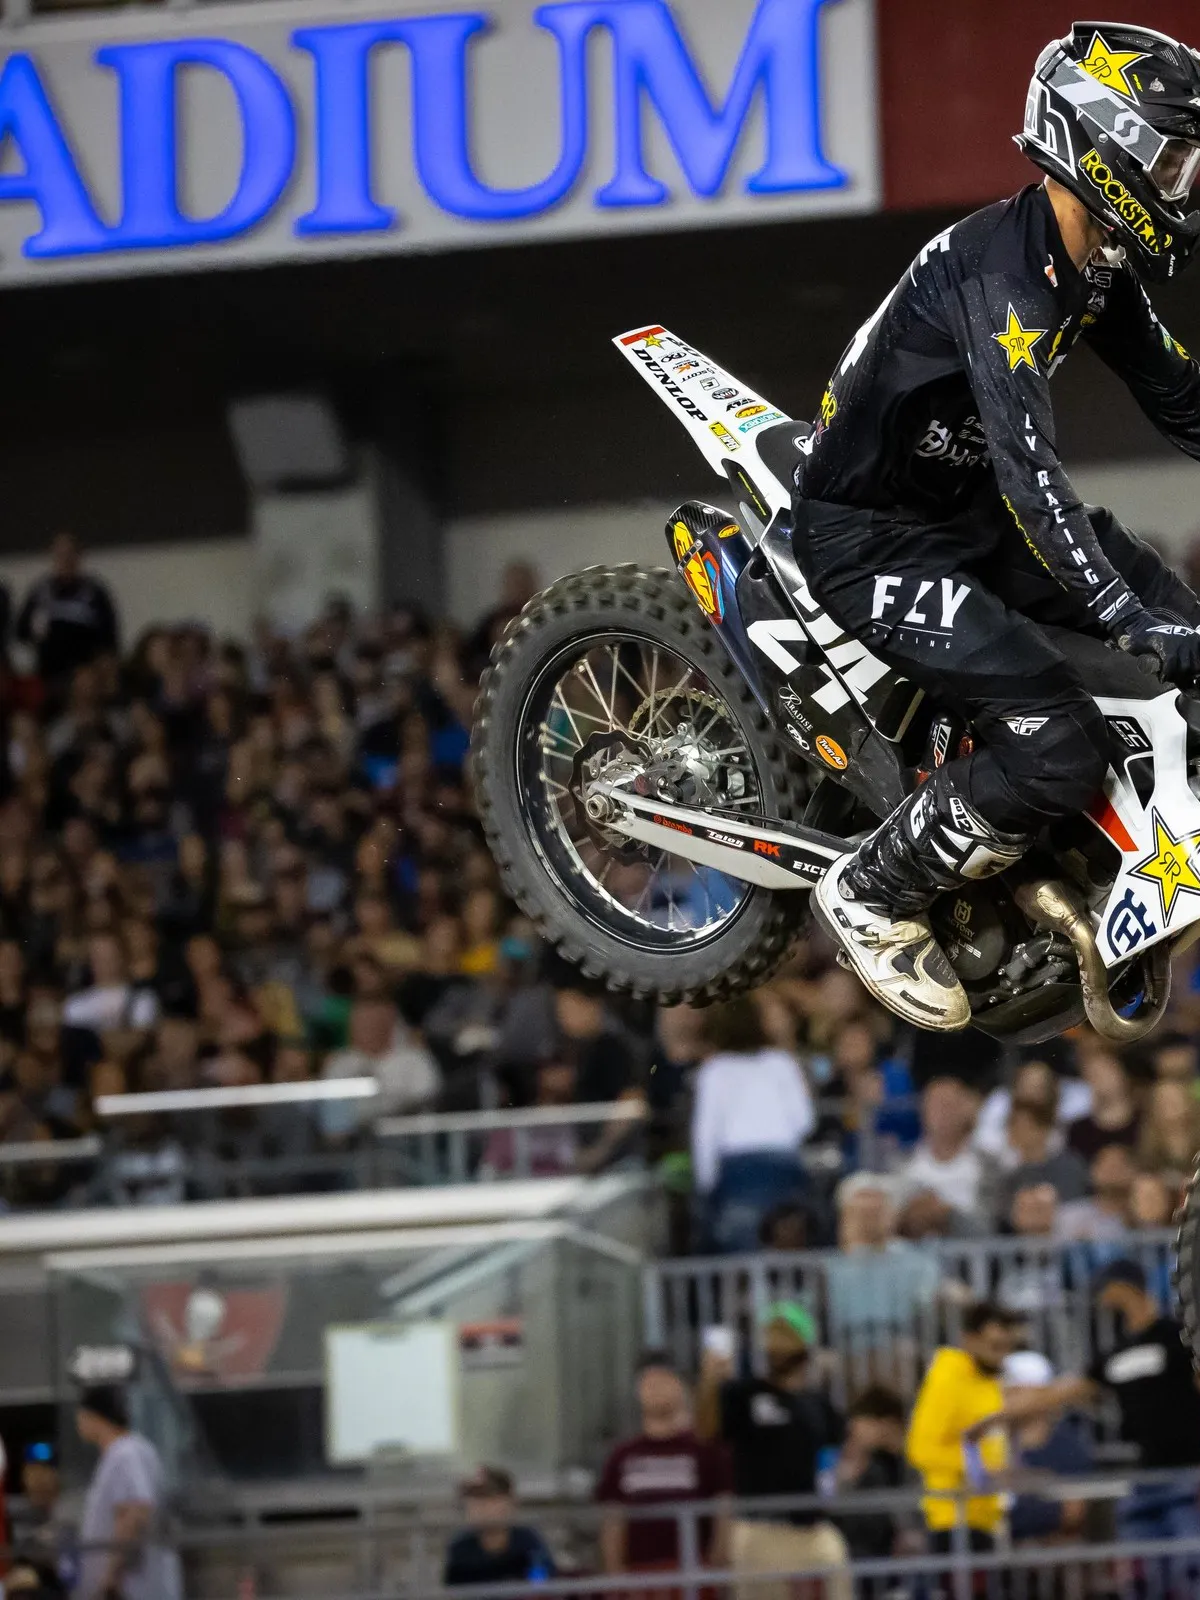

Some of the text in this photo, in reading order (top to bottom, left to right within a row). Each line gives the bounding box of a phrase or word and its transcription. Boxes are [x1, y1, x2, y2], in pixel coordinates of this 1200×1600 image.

[631, 348, 708, 422] DUNLOP
[1037, 470, 1099, 585] RACING
[870, 574, 972, 629] FLY
[1115, 720, 1149, 748] FC
[662, 818, 693, 837] brembo
[706, 829, 744, 848] Talon
[753, 839, 782, 857] RK
[792, 860, 828, 877] EXCE
